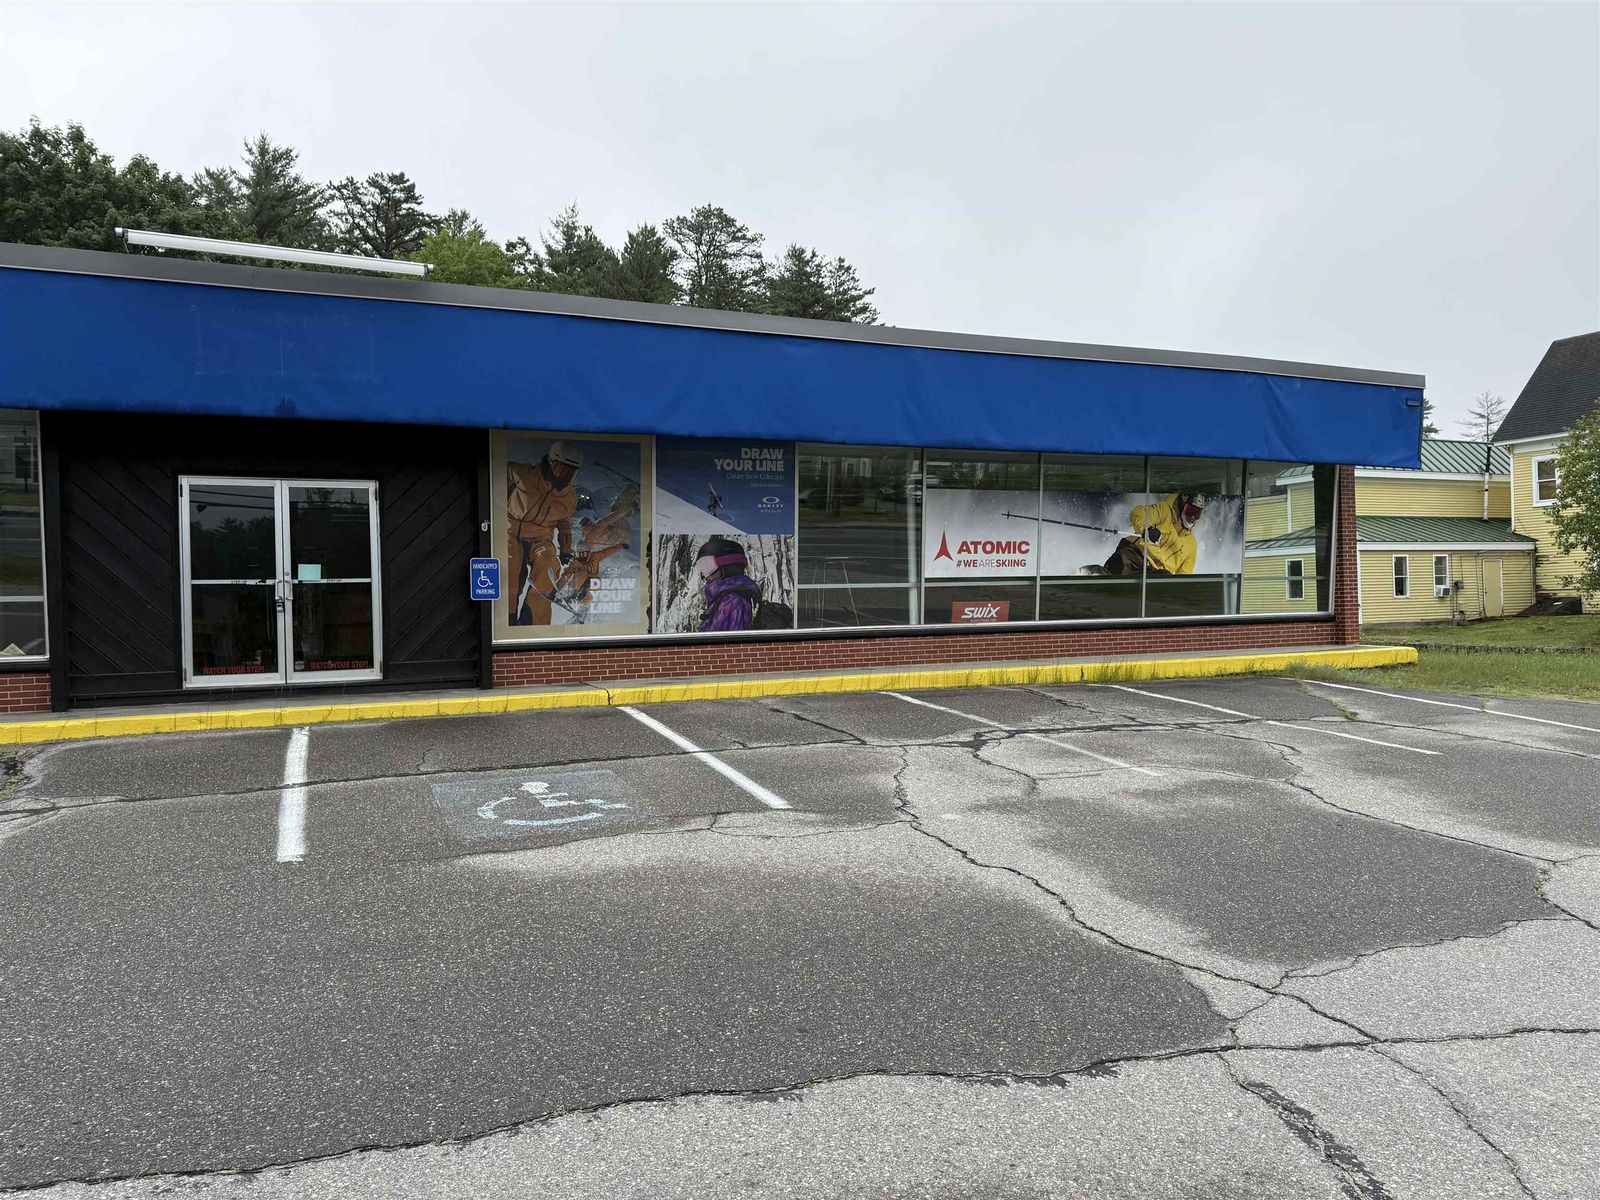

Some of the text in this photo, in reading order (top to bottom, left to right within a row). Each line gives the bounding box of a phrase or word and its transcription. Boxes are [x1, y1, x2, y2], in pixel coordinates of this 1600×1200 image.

[741, 448, 784, 459] DRAW
[713, 459, 784, 471] YOUR LINE
[957, 541, 1030, 554] ATOMIC
[956, 559, 1027, 567] #WEARESKIING
[590, 578, 636, 590] DRAW
[590, 590, 632, 602] YOUR
[590, 602, 622, 614] LINE
[203, 667, 225, 675] WATCH
[246, 665, 265, 673] STEP!
[310, 662, 333, 670] WATCH
[334, 661, 350, 669] YOUR
[352, 660, 368, 669] STEP!
